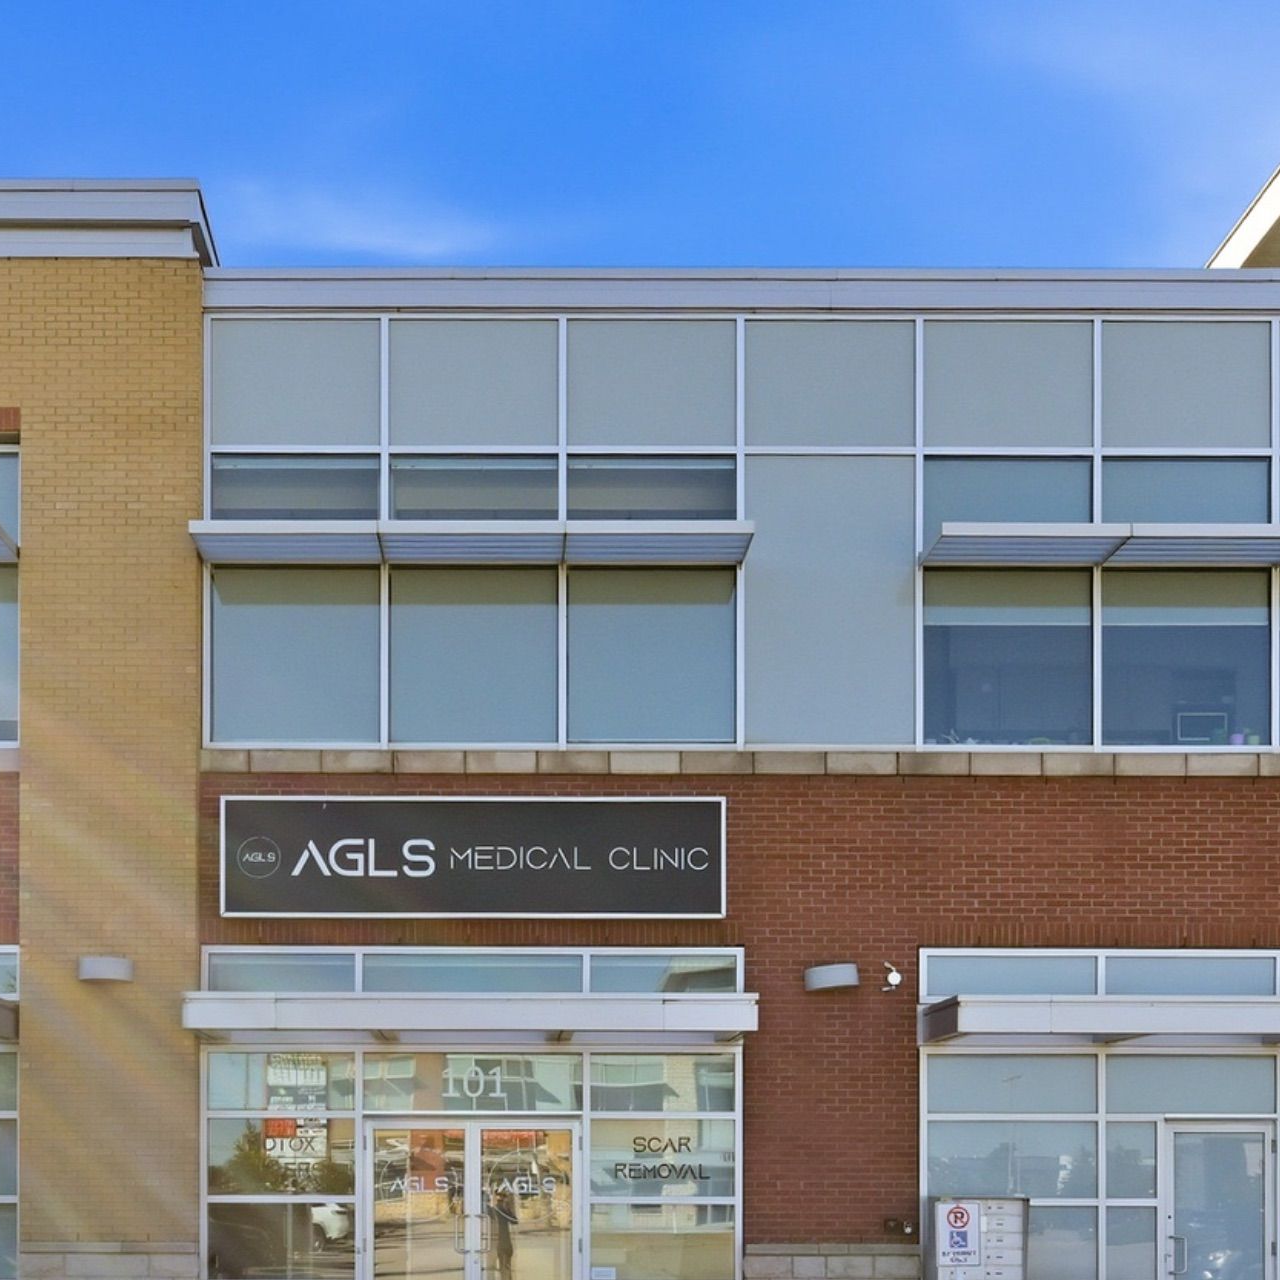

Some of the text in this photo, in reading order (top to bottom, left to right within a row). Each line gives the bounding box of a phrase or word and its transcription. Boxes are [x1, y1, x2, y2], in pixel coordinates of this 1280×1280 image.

[242, 853, 276, 863] AGLS
[290, 838, 709, 878] AGLS MEDICAL CLINIC
[441, 1066, 508, 1098] 101
[632, 1136, 692, 1153] SCAR
[614, 1163, 710, 1181] REMOVAL
[390, 1176, 450, 1193] AGLS
[497, 1176, 557, 1193] AGLS
